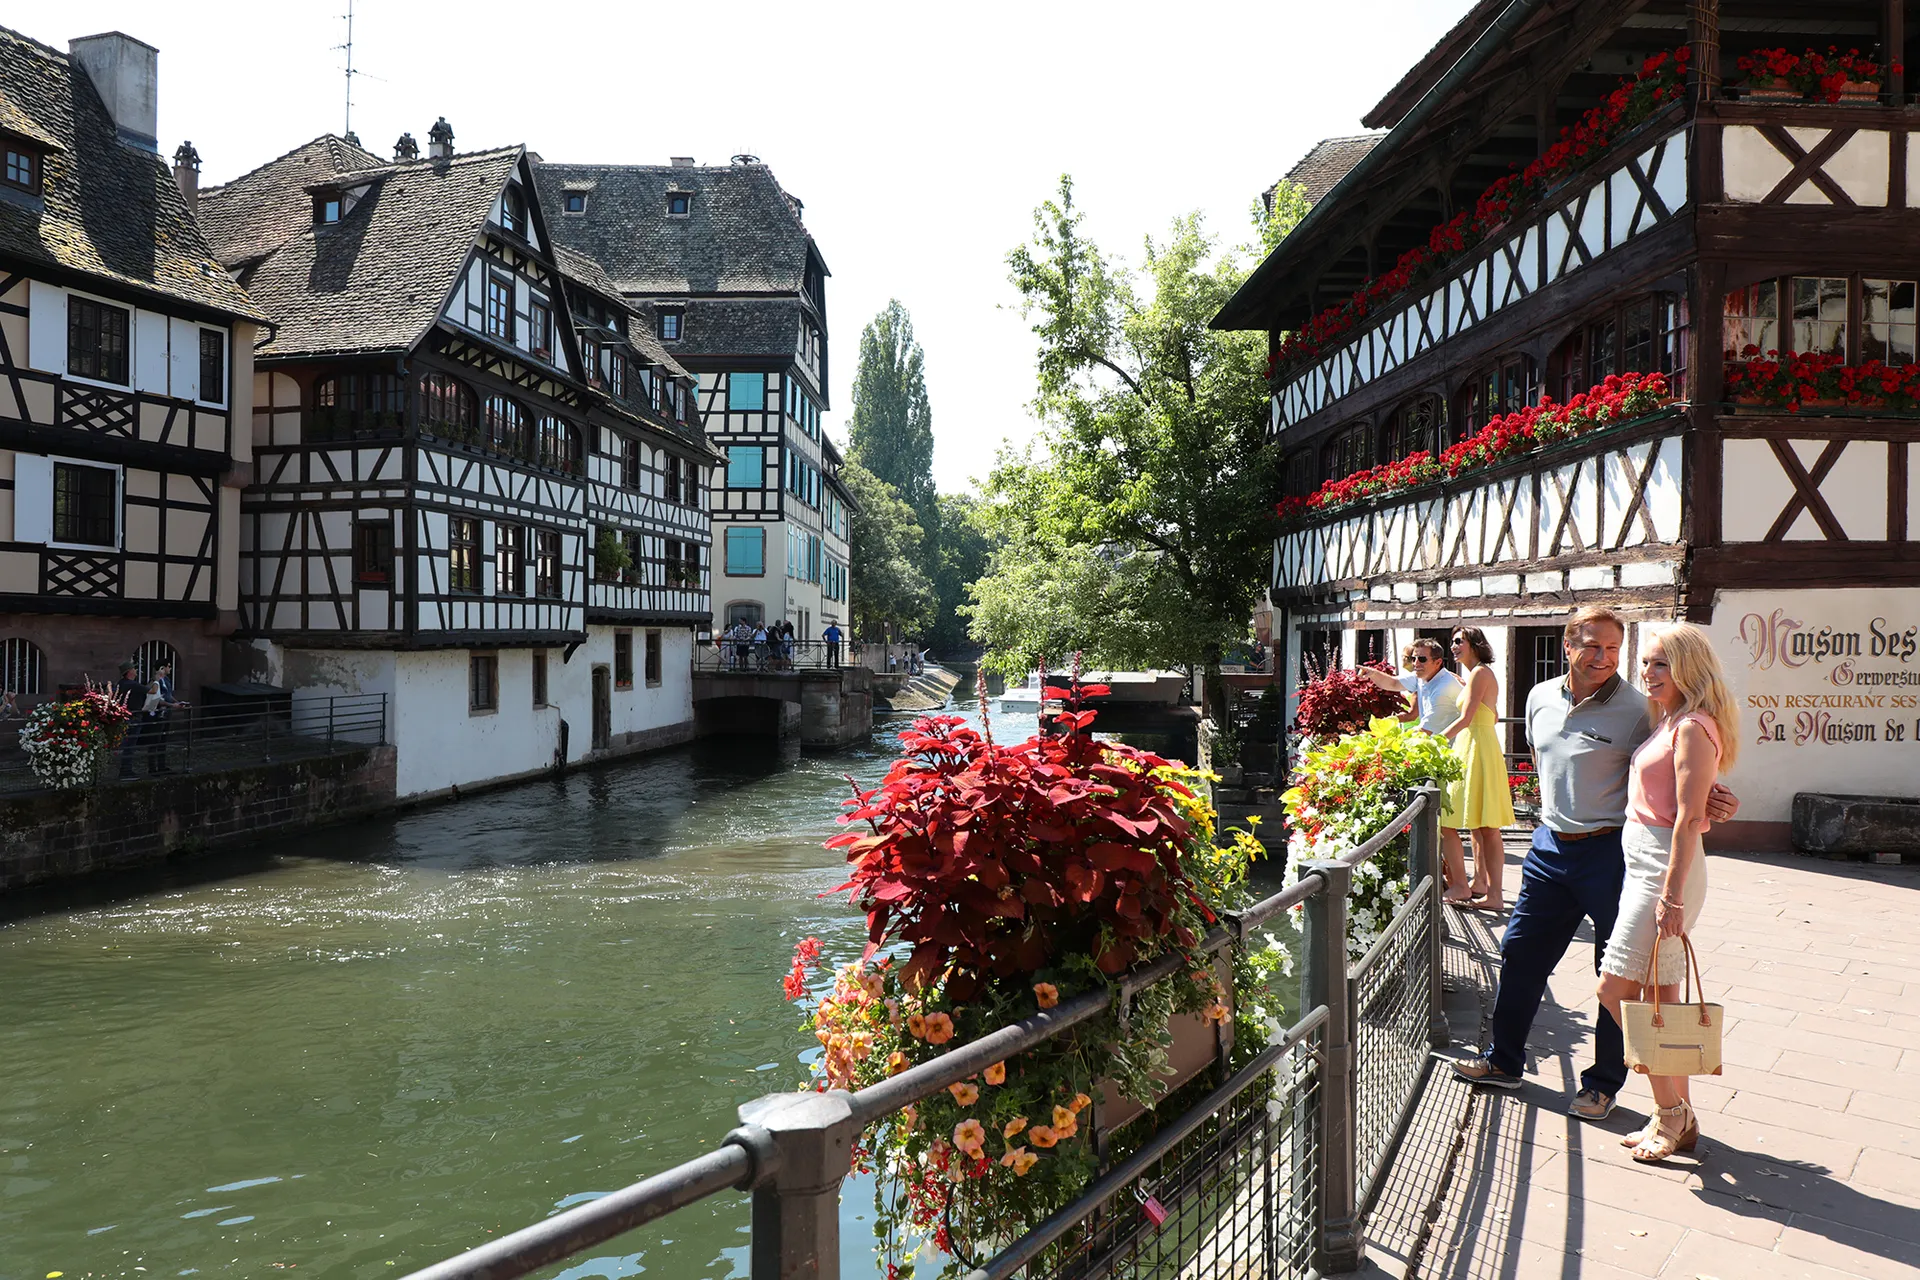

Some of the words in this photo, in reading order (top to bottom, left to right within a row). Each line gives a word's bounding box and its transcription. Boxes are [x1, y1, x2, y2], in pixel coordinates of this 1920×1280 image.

[1738, 608, 1862, 670] Maison
[1867, 617, 1918, 663] des
[1747, 694, 1780, 708] SON
[1784, 694, 1886, 708] RESTAURANT
[1890, 694, 1917, 708] SES
[1757, 710, 1786, 745] La
[1793, 709, 1877, 746] Maison
[1885, 718, 1905, 742] de
